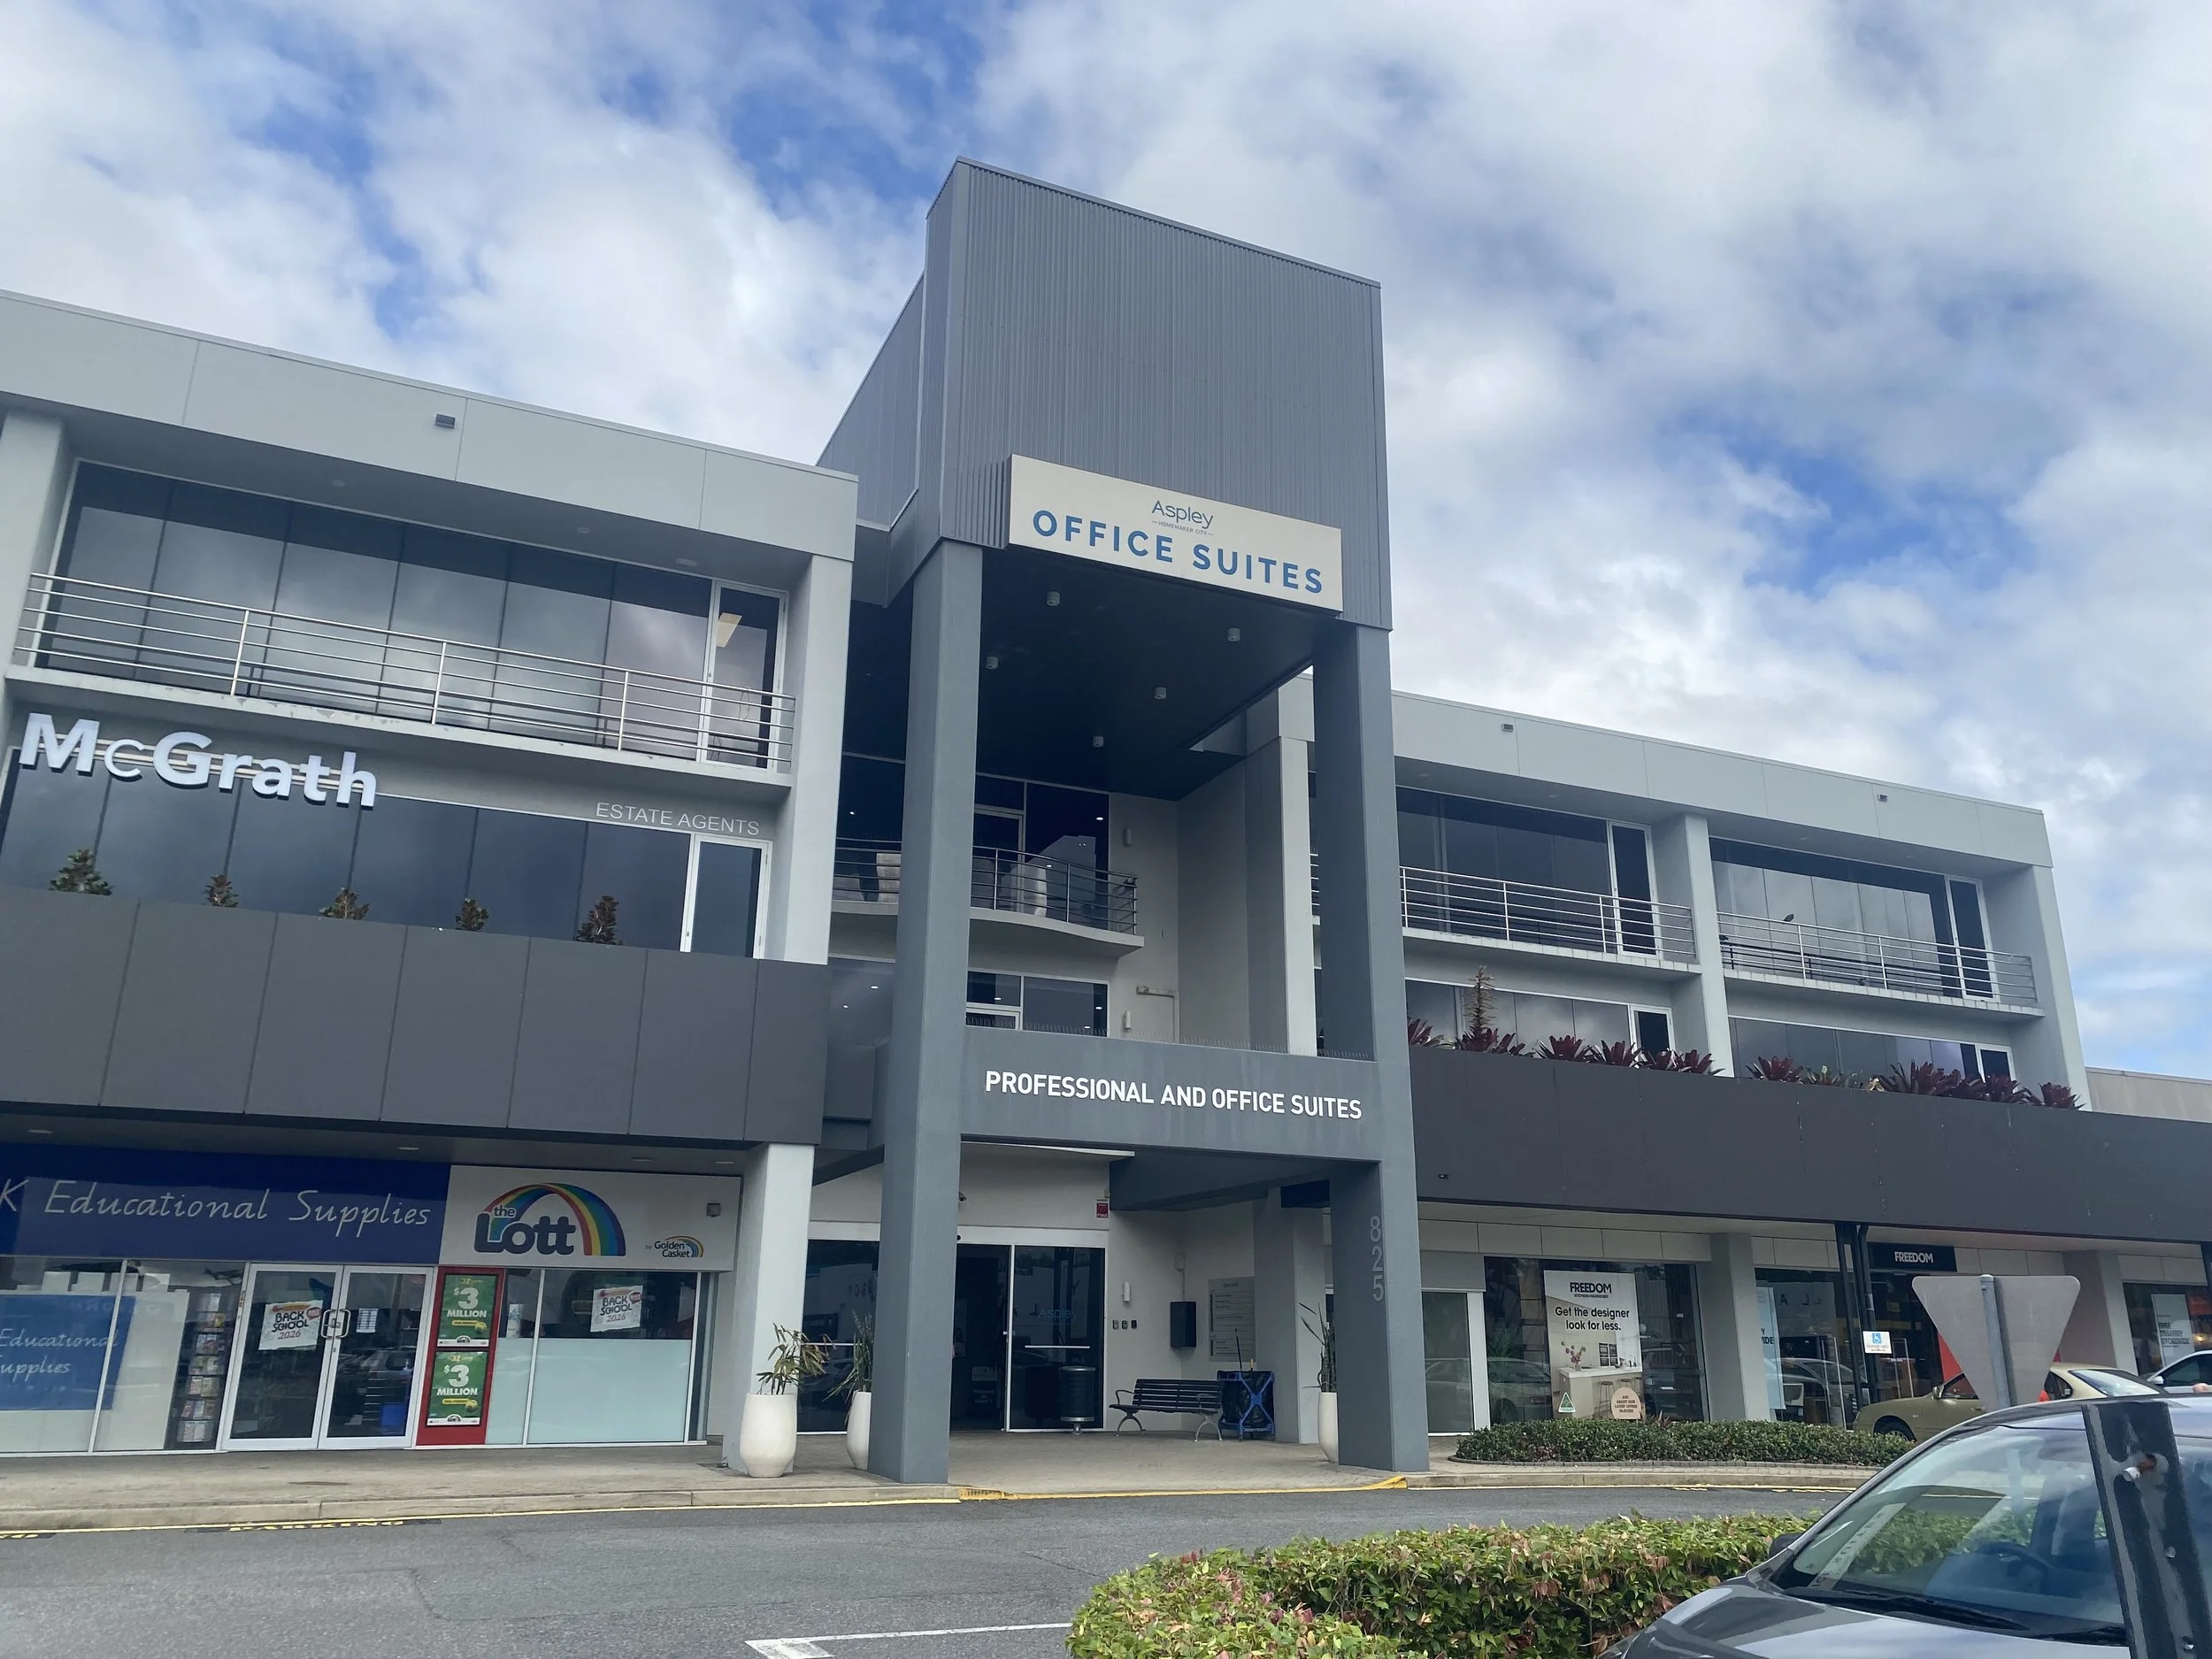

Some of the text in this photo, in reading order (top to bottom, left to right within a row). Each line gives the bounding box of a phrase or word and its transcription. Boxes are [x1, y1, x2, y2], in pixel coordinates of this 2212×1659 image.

[1152, 500, 1213, 529] Aspley
[1158, 521, 1194, 534] HOMEMAKER
[1033, 510, 1323, 594] OFFICE SUITES
[19, 712, 378, 808] McGrath
[595, 802, 760, 836] ESTATE AGENTS
[985, 1071, 1363, 1120] PROFESSIONAL AND OFFICE SUITES
[44, 1179, 269, 1220] Educational
[288, 1189, 432, 1239] Supplies
[493, 1204, 516, 1218] the
[473, 1212, 576, 1256] Lott
[654, 1240, 685, 1249] Golden
[662, 1248, 690, 1257] Casket
[1894, 1251, 1934, 1263] FREEDOM
[1570, 1282, 1612, 1294] FREEDOM
[453, 1286, 480, 1310] $3
[603, 1295, 628, 1307] BACK
[446, 1310, 488, 1318] MILLION
[600, 1303, 633, 1316] SCHOOL
[1038, 1307, 1079, 1323] Aspley
[1555, 1306, 1630, 1320] Get the designer
[275, 1310, 305, 1324] BACK
[606, 1313, 626, 1323] 2026
[271, 1319, 310, 1333] SCHOOL
[1565, 1320, 1622, 1331] look for less.
[277, 1330, 302, 1340] 2026
[0, 1355, 72, 1382] upplies
[443, 1364, 470, 1387] $3
[436, 1387, 478, 1396] MILLION
